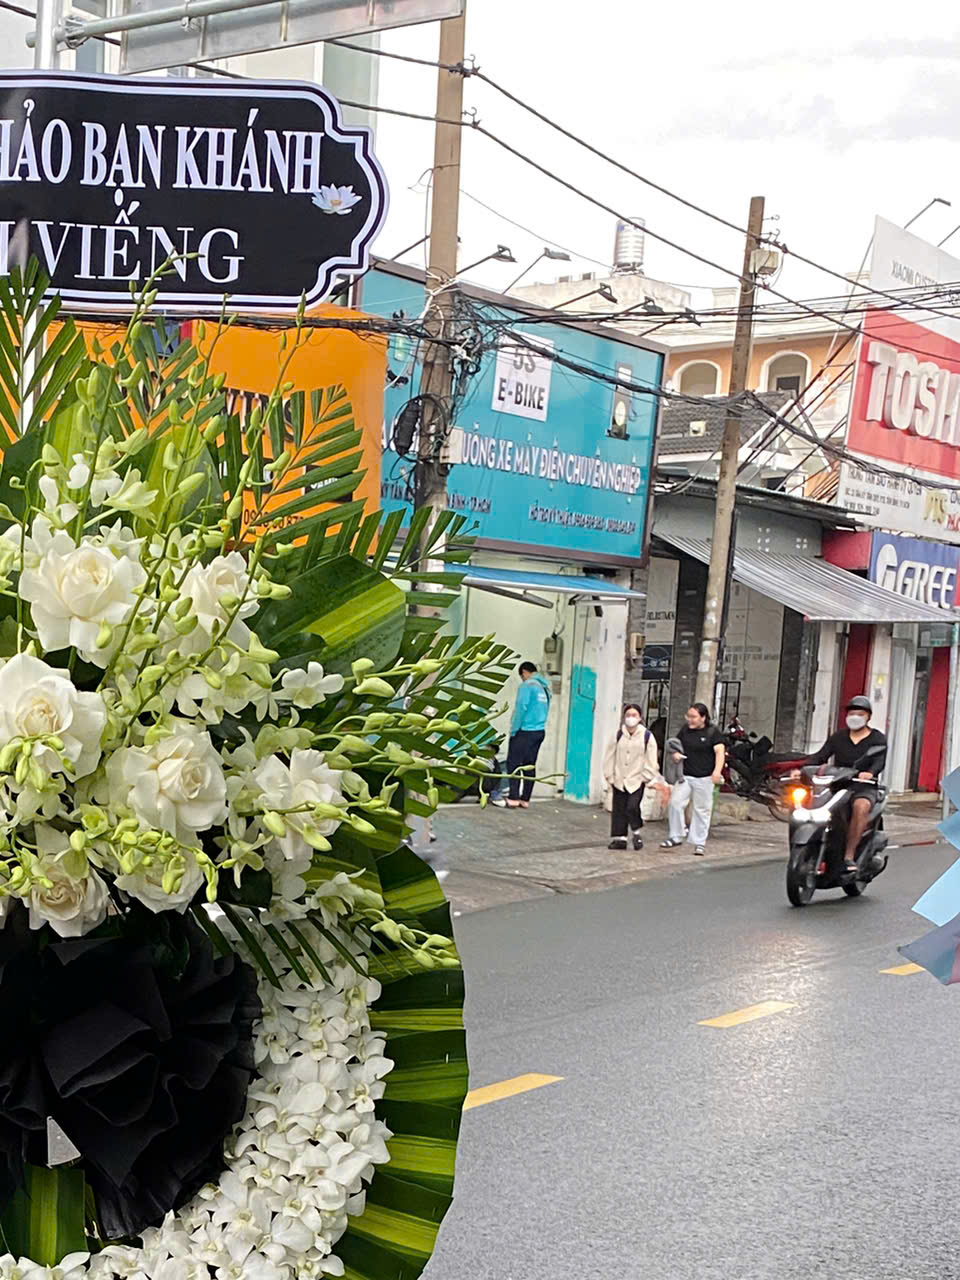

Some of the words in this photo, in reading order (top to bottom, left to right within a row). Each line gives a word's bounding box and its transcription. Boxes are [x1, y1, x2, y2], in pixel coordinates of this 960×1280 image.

[172, 108, 325, 194] KHÁNH
[30, 200, 246, 284] VIẾNG
[497, 438, 513, 472] XE
